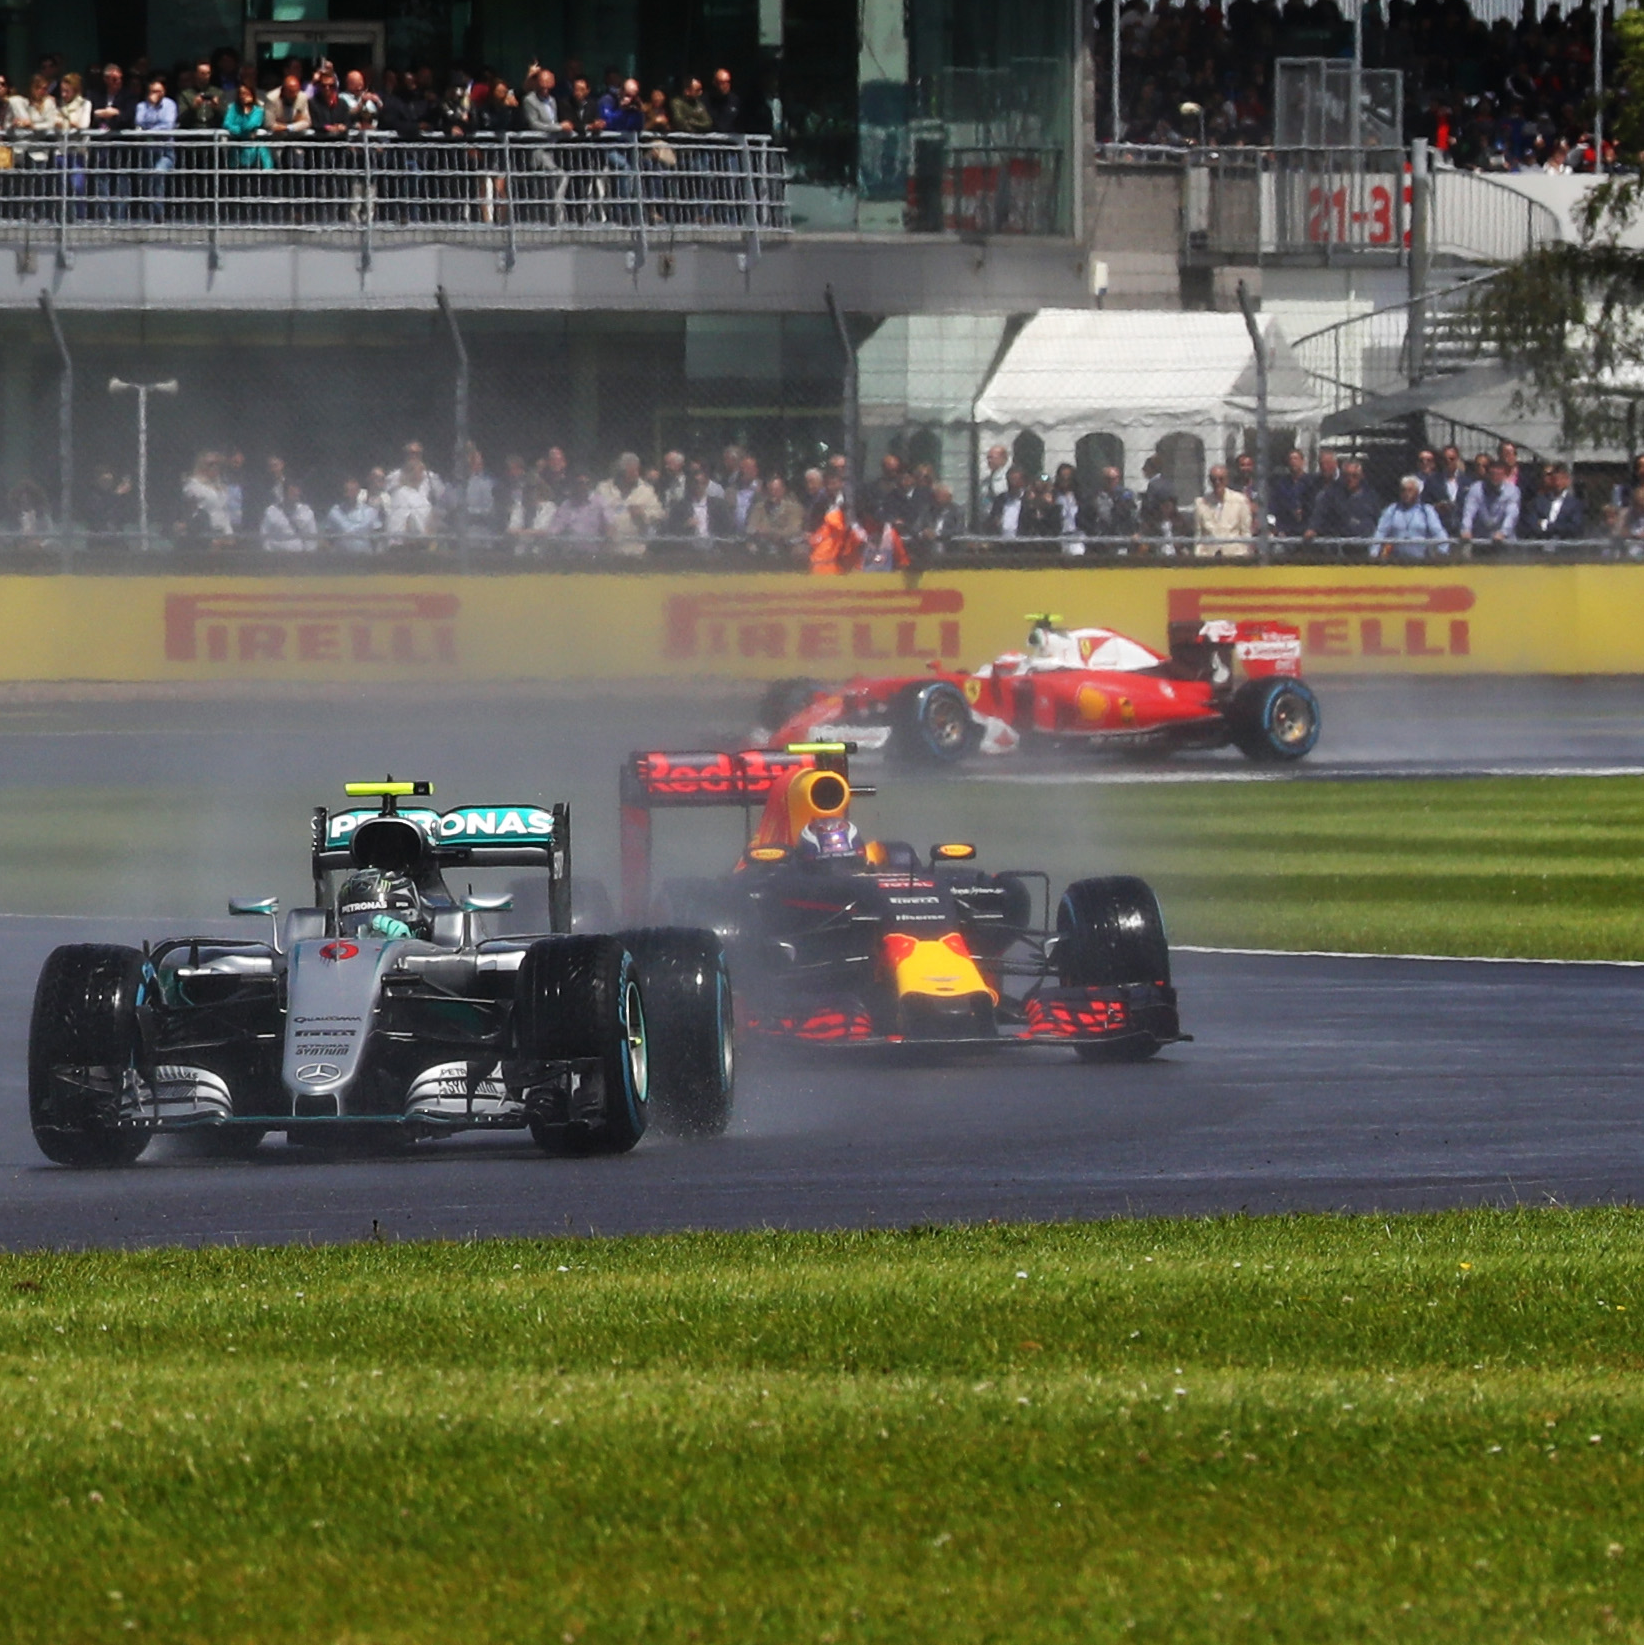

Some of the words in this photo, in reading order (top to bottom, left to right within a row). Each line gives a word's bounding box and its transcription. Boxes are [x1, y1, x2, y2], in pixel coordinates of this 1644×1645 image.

[165, 593, 460, 662] PIRELLI
[662, 588, 964, 659] PIRELLI
[1167, 585, 1476, 657] PELLI
[648, 751, 733, 793] Red
[330, 811, 555, 838] PRONAS
[342, 901, 388, 914] PETRONAS
